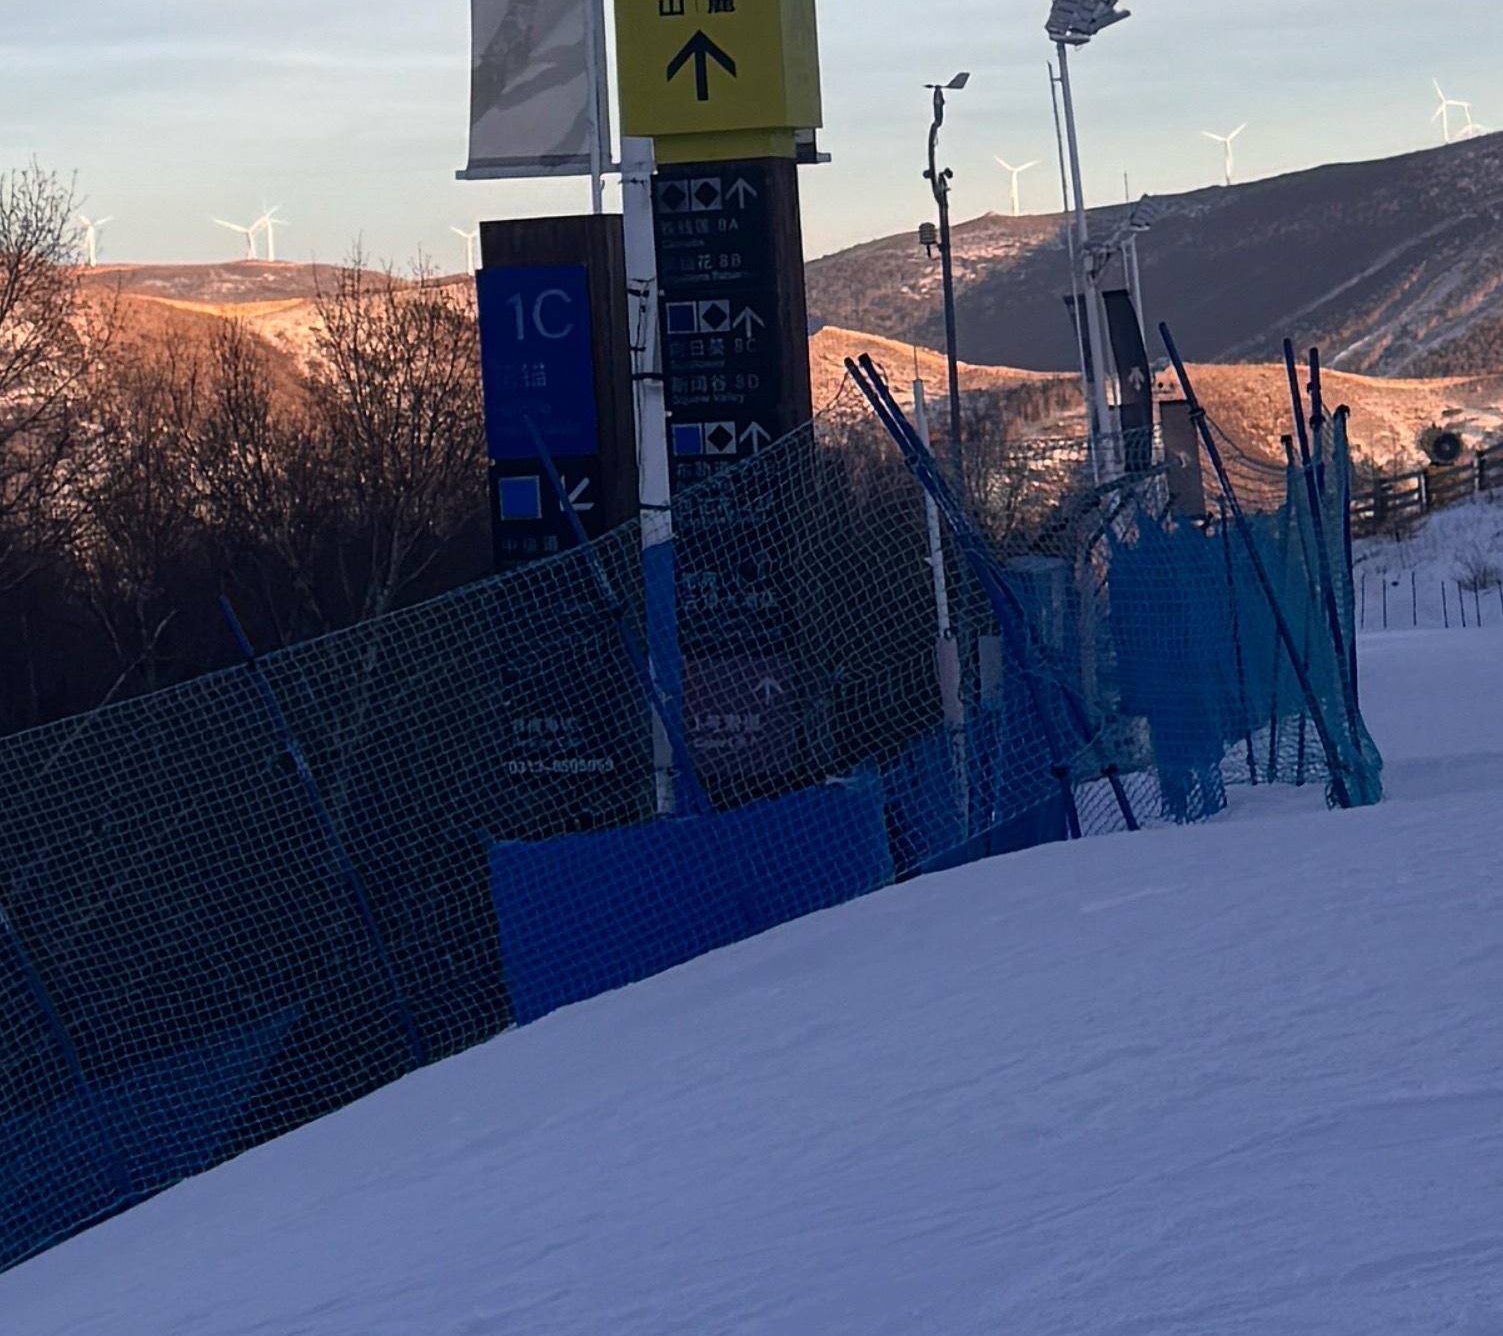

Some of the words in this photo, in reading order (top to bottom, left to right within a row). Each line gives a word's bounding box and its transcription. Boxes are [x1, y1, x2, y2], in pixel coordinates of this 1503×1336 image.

[719, 252, 742, 268] 8B
[506, 288, 574, 341] 1C
[734, 337, 756, 353] 8C
[735, 373, 760, 390] 8D
